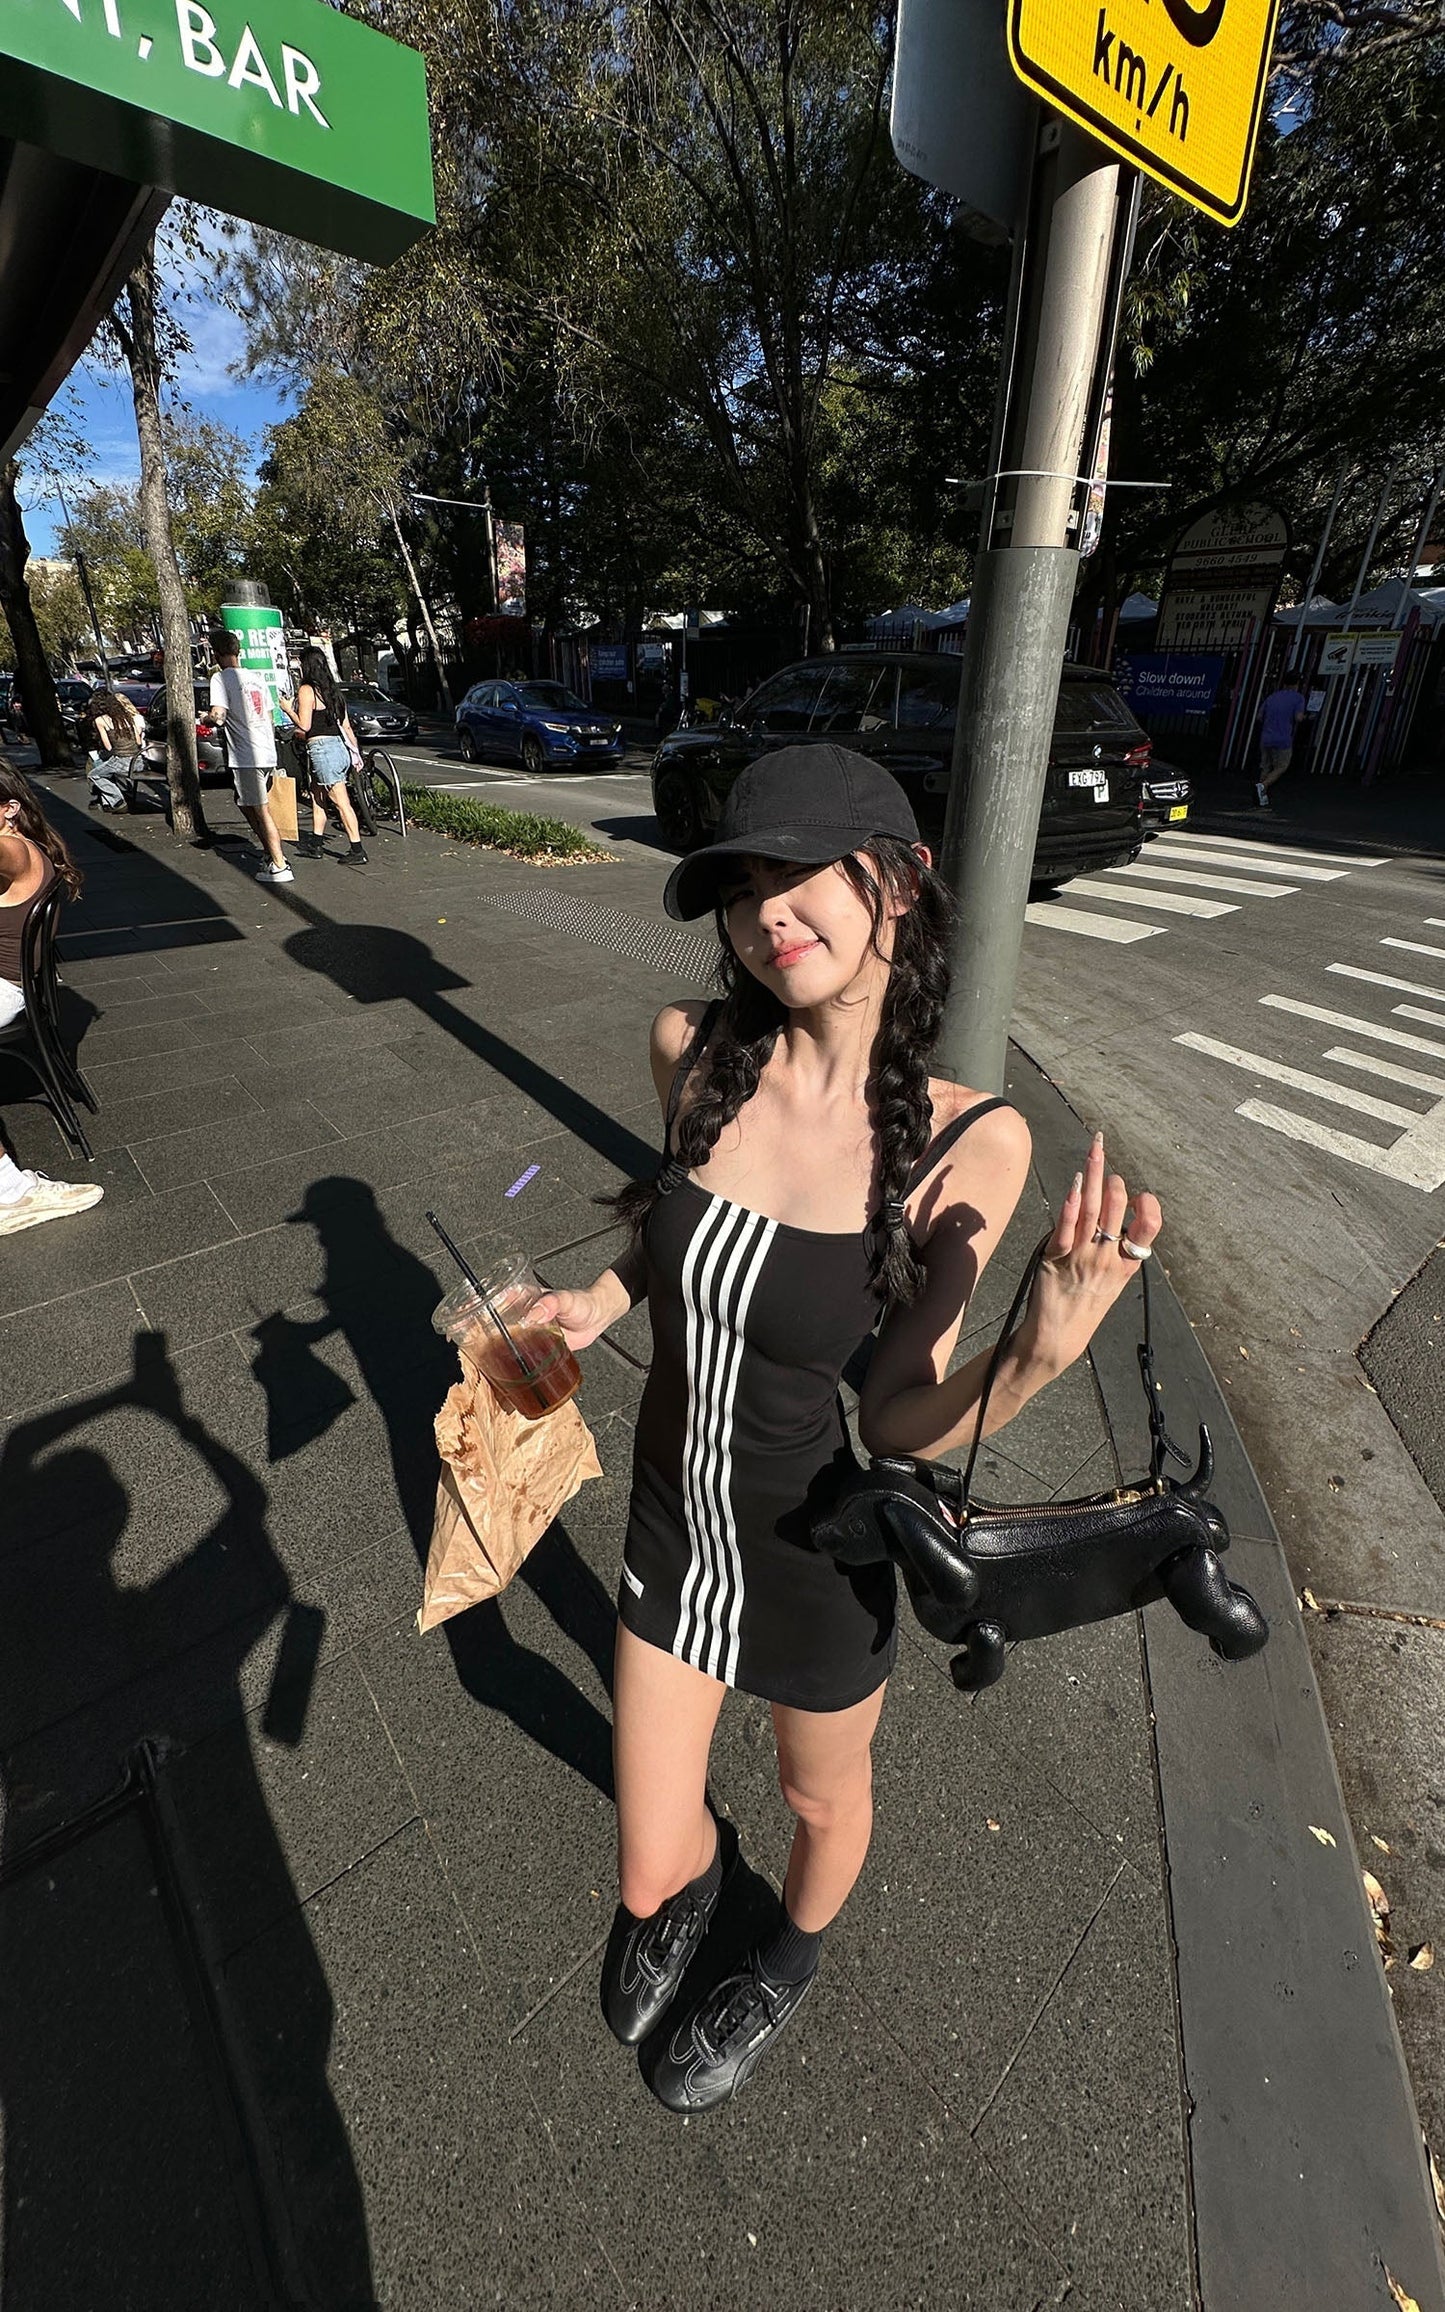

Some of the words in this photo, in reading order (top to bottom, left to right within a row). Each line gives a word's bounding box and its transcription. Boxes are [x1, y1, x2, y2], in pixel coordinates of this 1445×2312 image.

[175, 0, 333, 130] BAR
[1092, 8, 1190, 142] km/h
[1136, 685, 1175, 698] Children
[1176, 688, 1212, 700] around
[1138, 671, 1166, 684] Slow
[1168, 672, 1206, 686] down!
